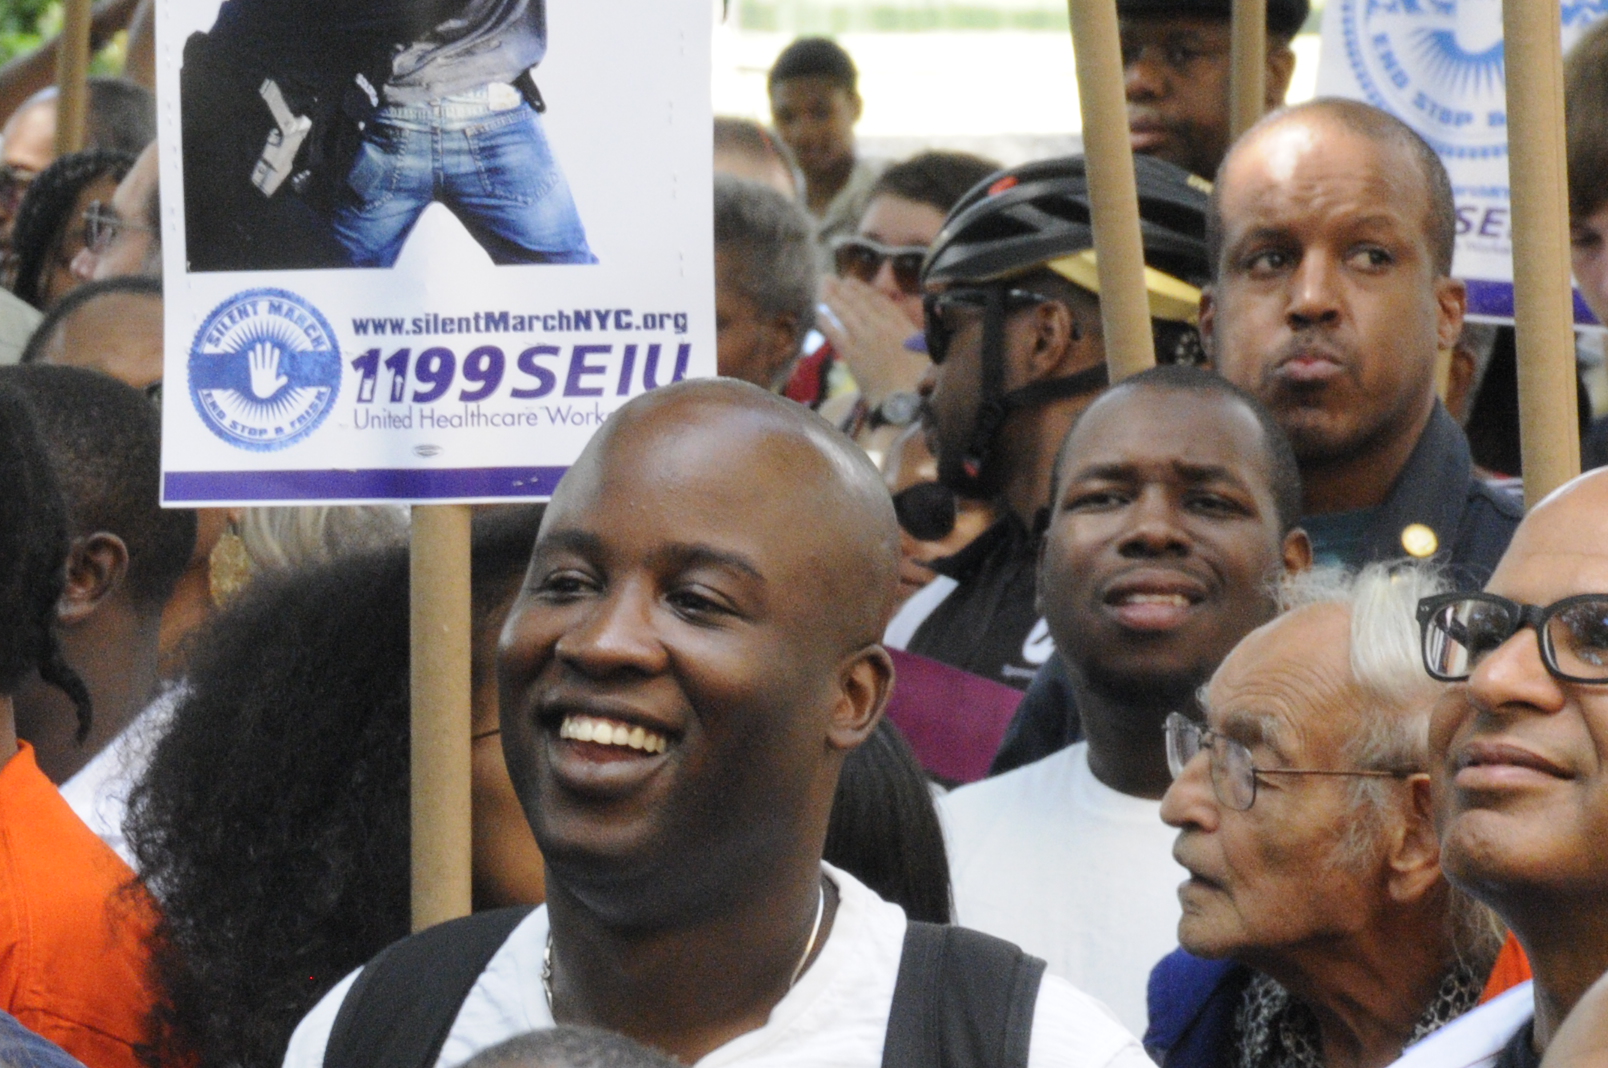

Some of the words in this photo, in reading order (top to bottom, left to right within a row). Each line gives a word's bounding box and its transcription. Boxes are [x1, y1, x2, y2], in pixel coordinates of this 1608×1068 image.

[206, 300, 260, 348] SILENT
[267, 299, 328, 352] MARCH
[351, 308, 689, 335] www.silentMarchNYC.org
[203, 390, 228, 422] END
[229, 419, 269, 438] STOP
[289, 389, 328, 430] FRISK
[353, 404, 414, 430] United
[419, 403, 539, 430] Healthcare
[546, 401, 605, 427] Work
